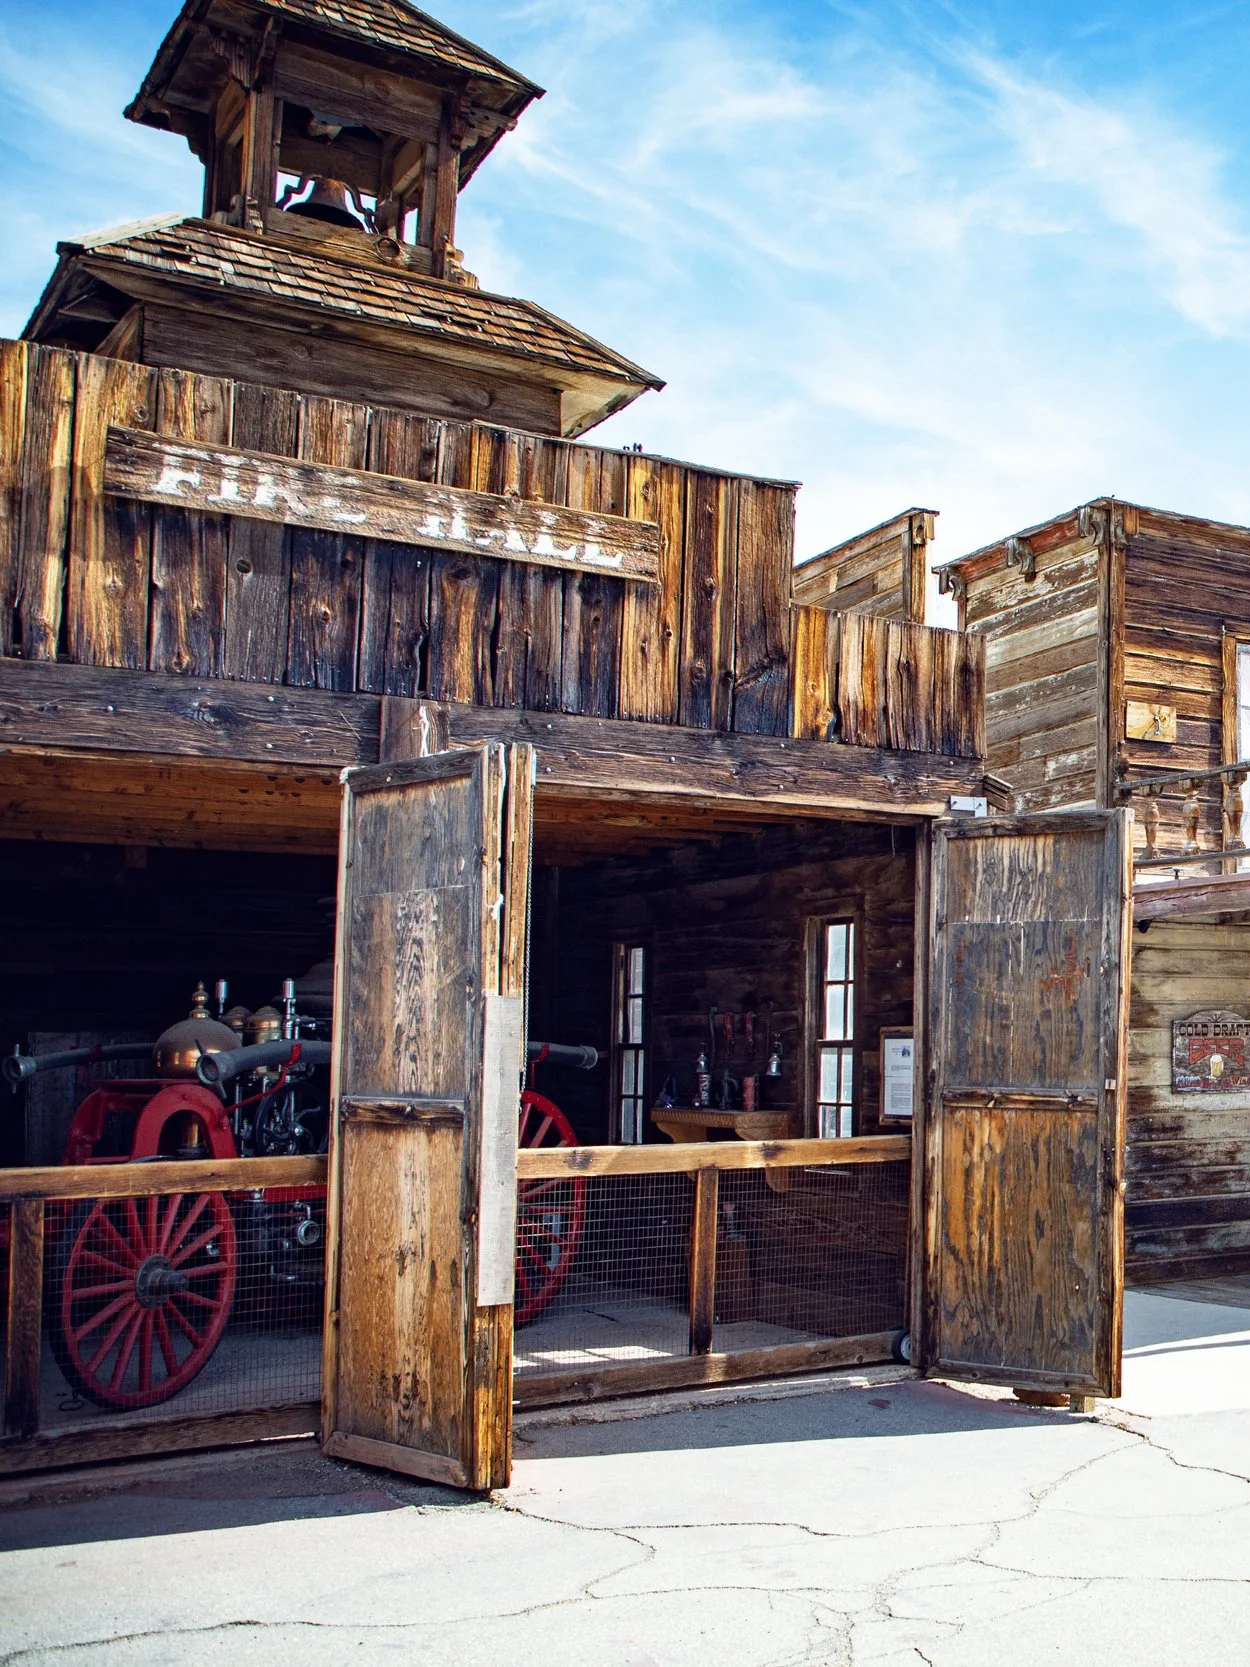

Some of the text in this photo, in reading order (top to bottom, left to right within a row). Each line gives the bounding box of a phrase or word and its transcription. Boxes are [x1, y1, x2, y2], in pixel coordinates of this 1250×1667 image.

[150, 441, 624, 568] FIRE HALL
[1179, 1024, 1250, 1036] COLD DRAFT
[1188, 1038, 1245, 1066] BEER
